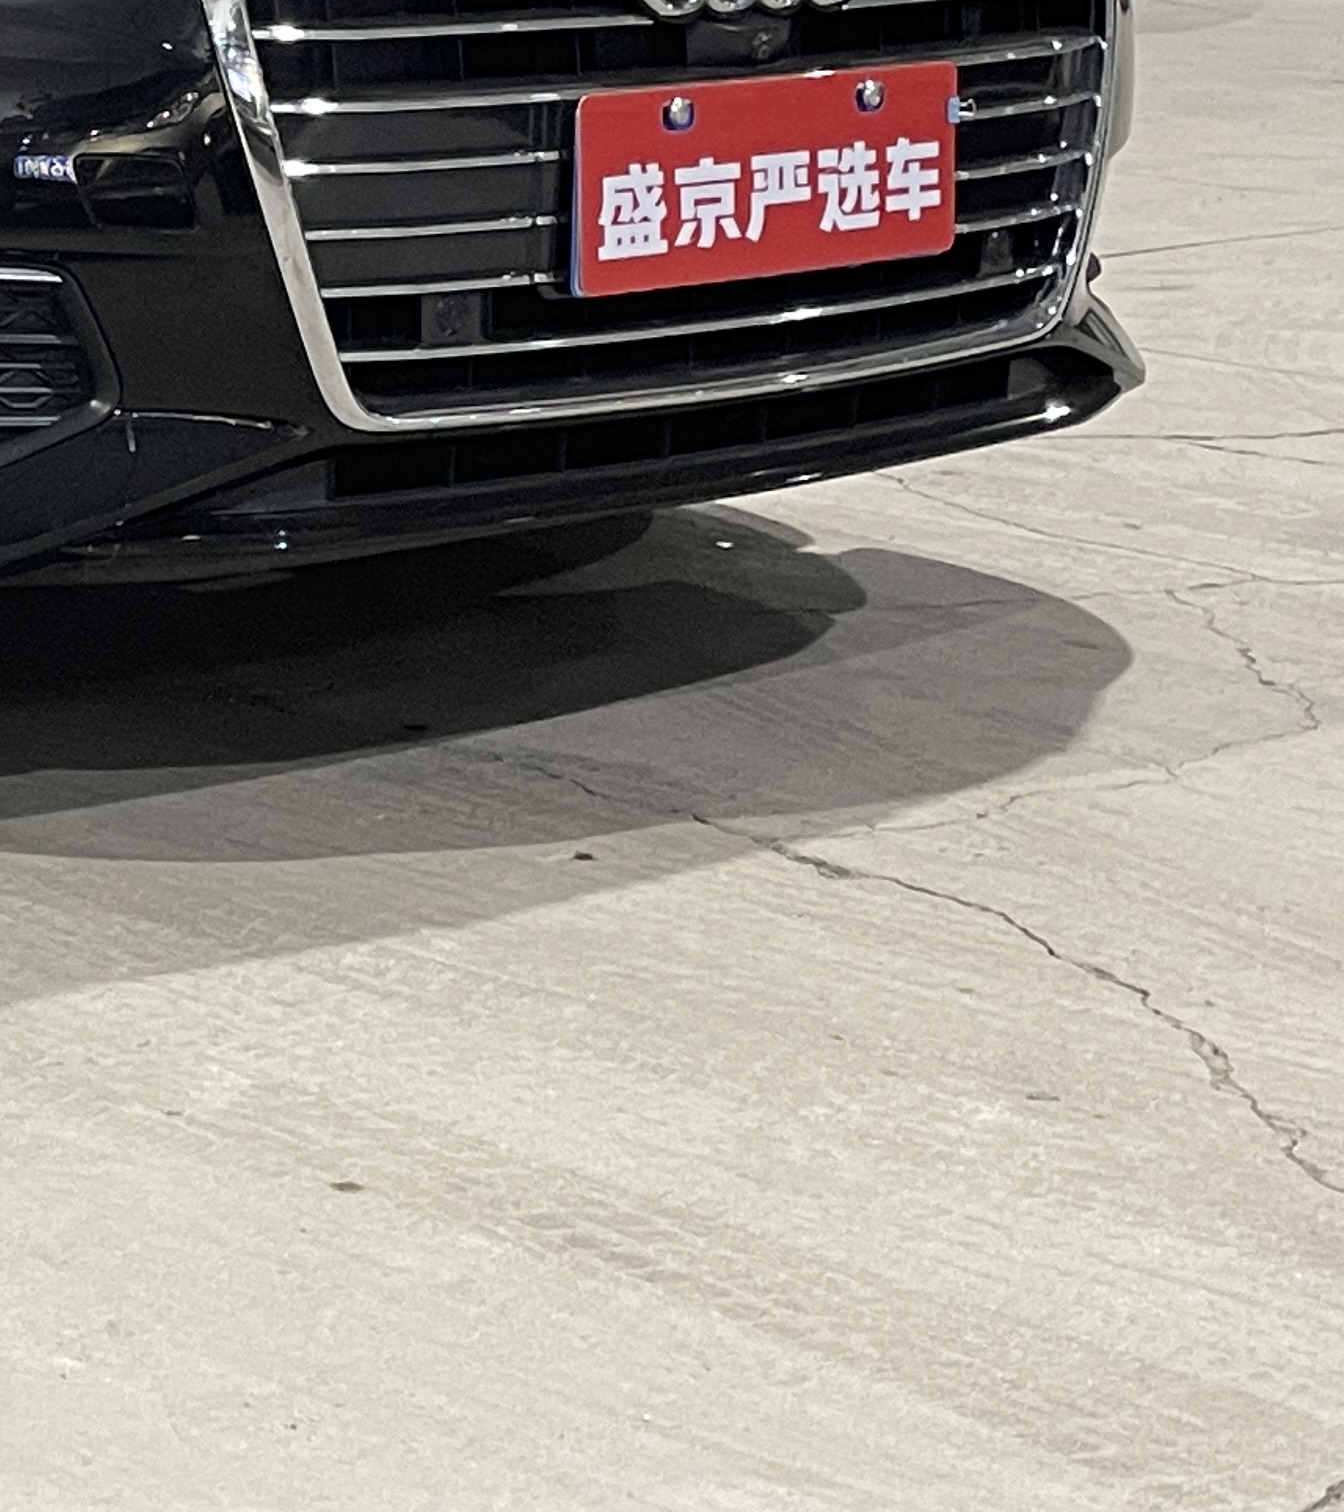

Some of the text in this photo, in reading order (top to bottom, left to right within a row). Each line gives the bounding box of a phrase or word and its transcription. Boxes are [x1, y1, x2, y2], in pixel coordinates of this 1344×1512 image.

[597, 136, 943, 262] 盛京严选车
